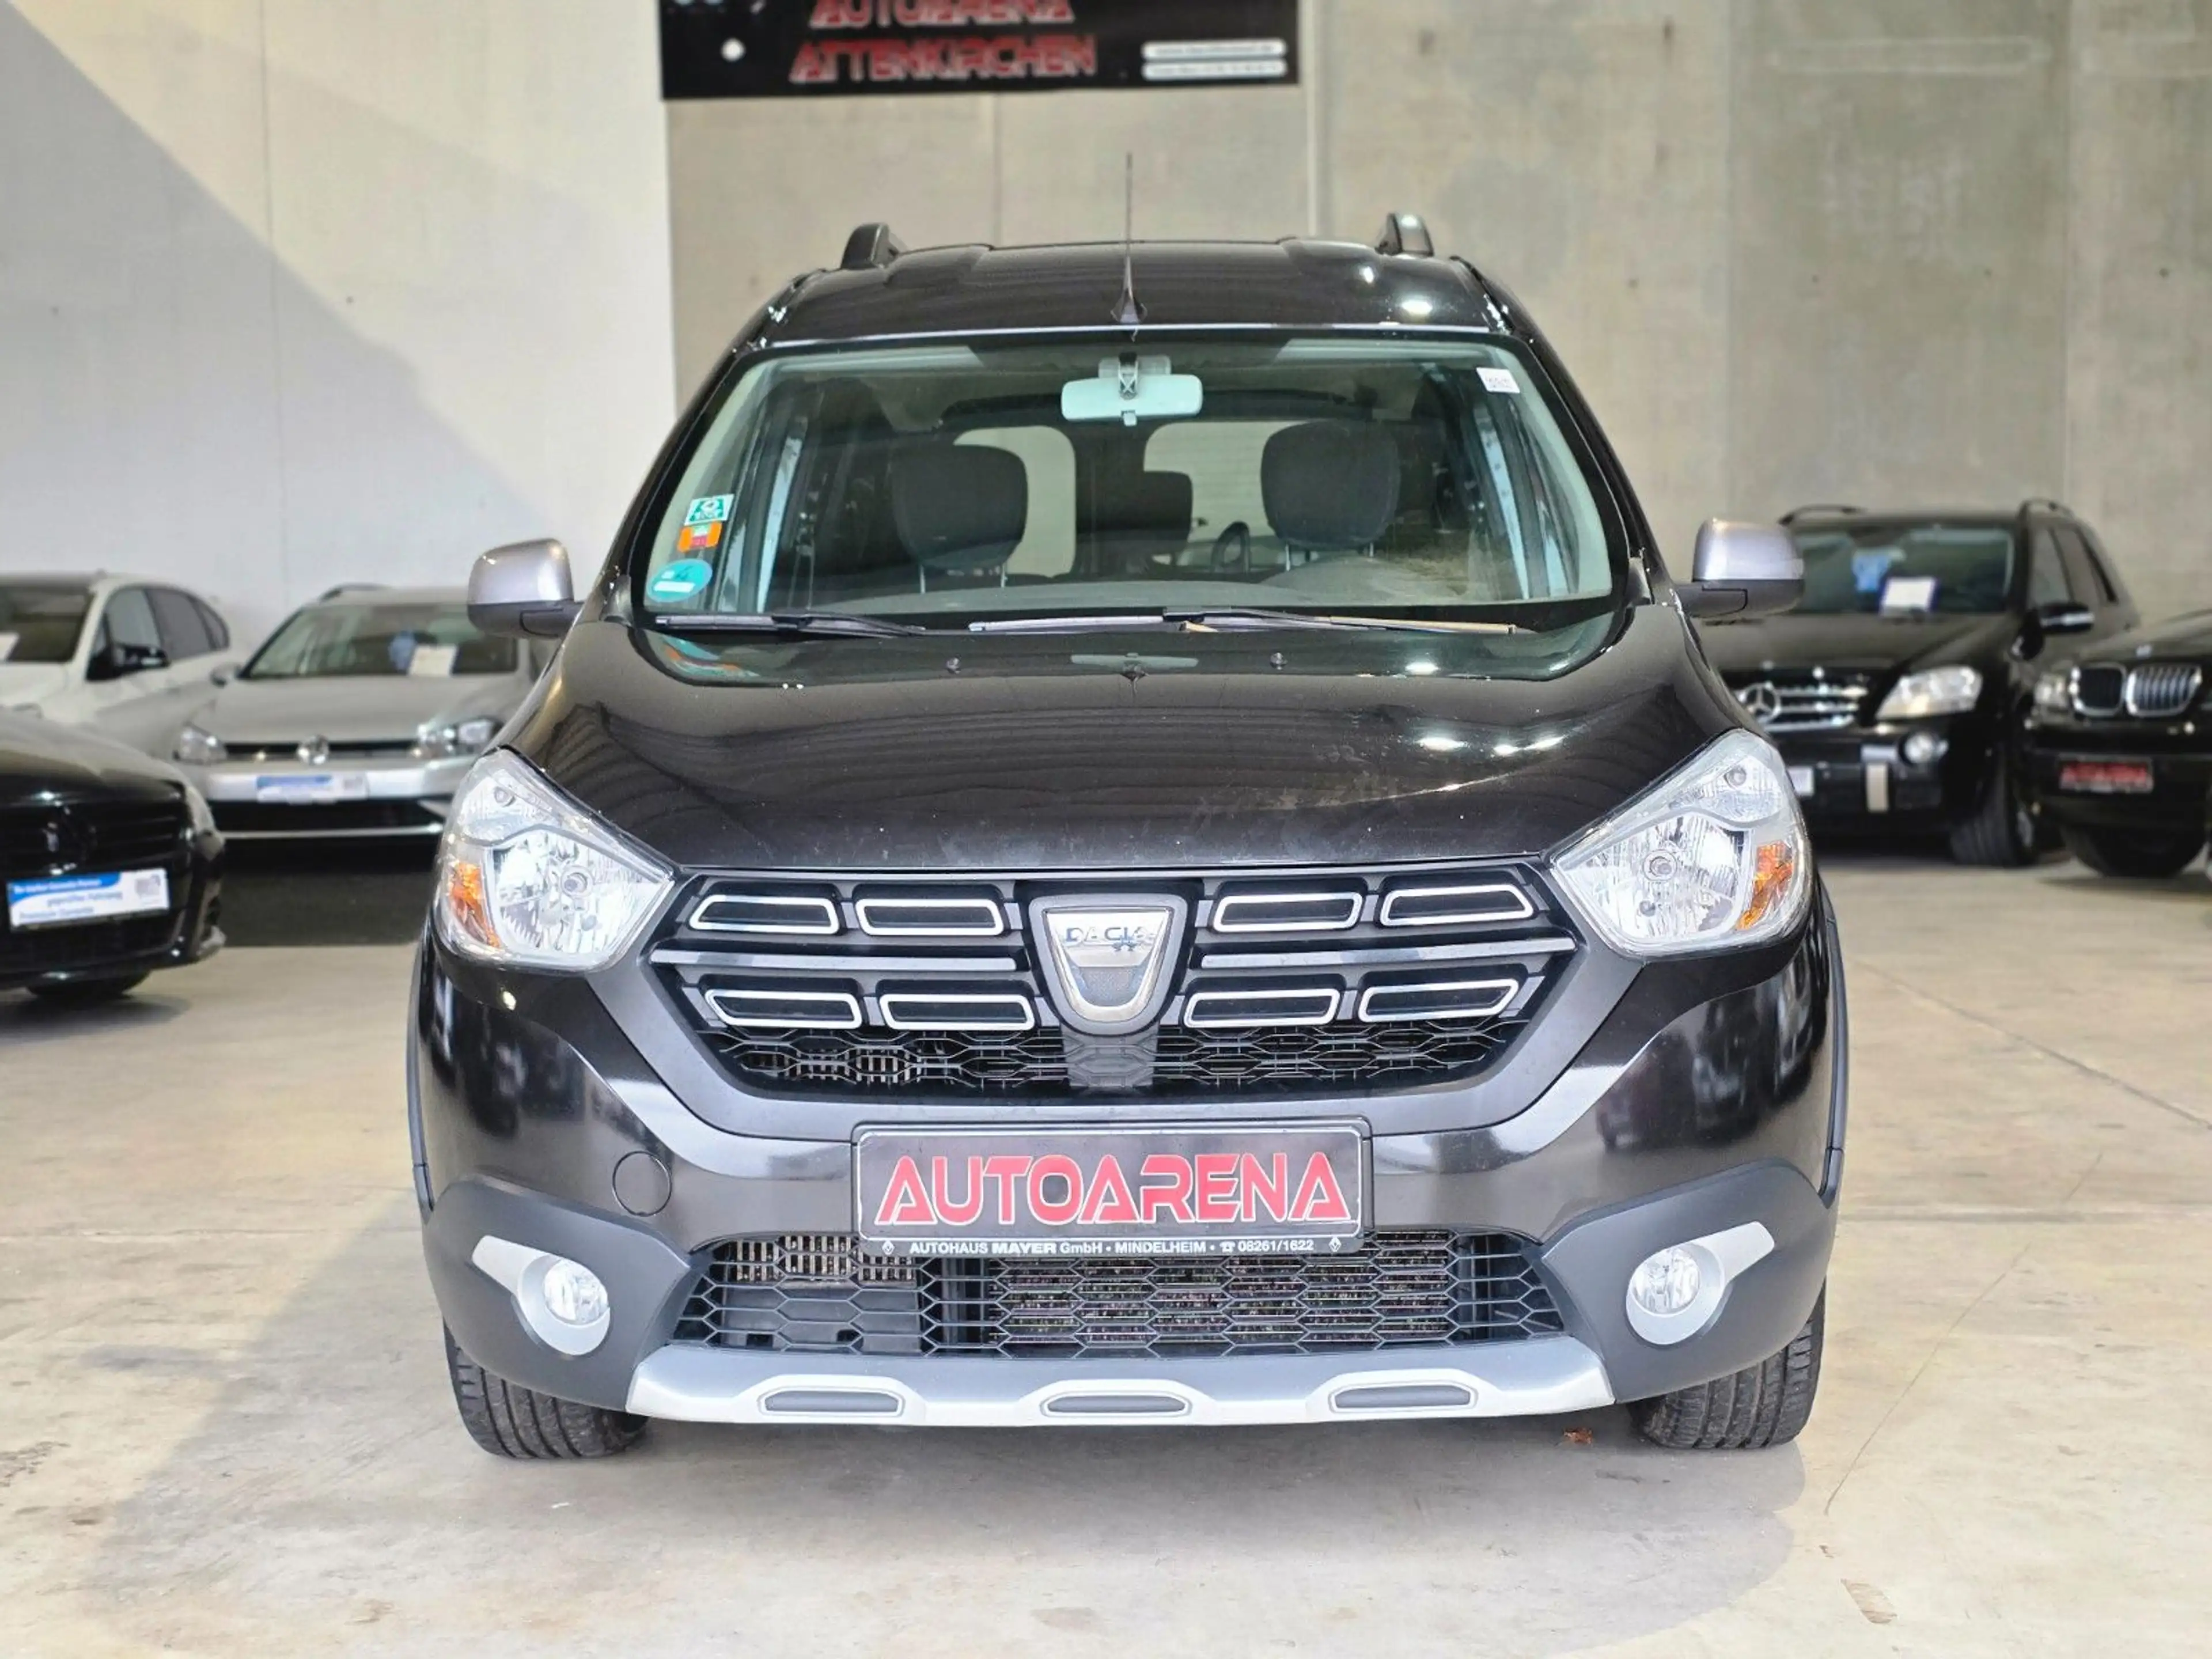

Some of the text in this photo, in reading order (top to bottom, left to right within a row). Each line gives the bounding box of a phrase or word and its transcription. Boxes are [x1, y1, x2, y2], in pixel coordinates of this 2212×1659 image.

[788, 33, 1098, 84] ATTENKIRCHEN
[874, 1152, 1350, 1226] AUTOARENA
[910, 1240, 1315, 1255] AUTOHAUS MAYER GmbH MINDELHEIM 08261/1622
